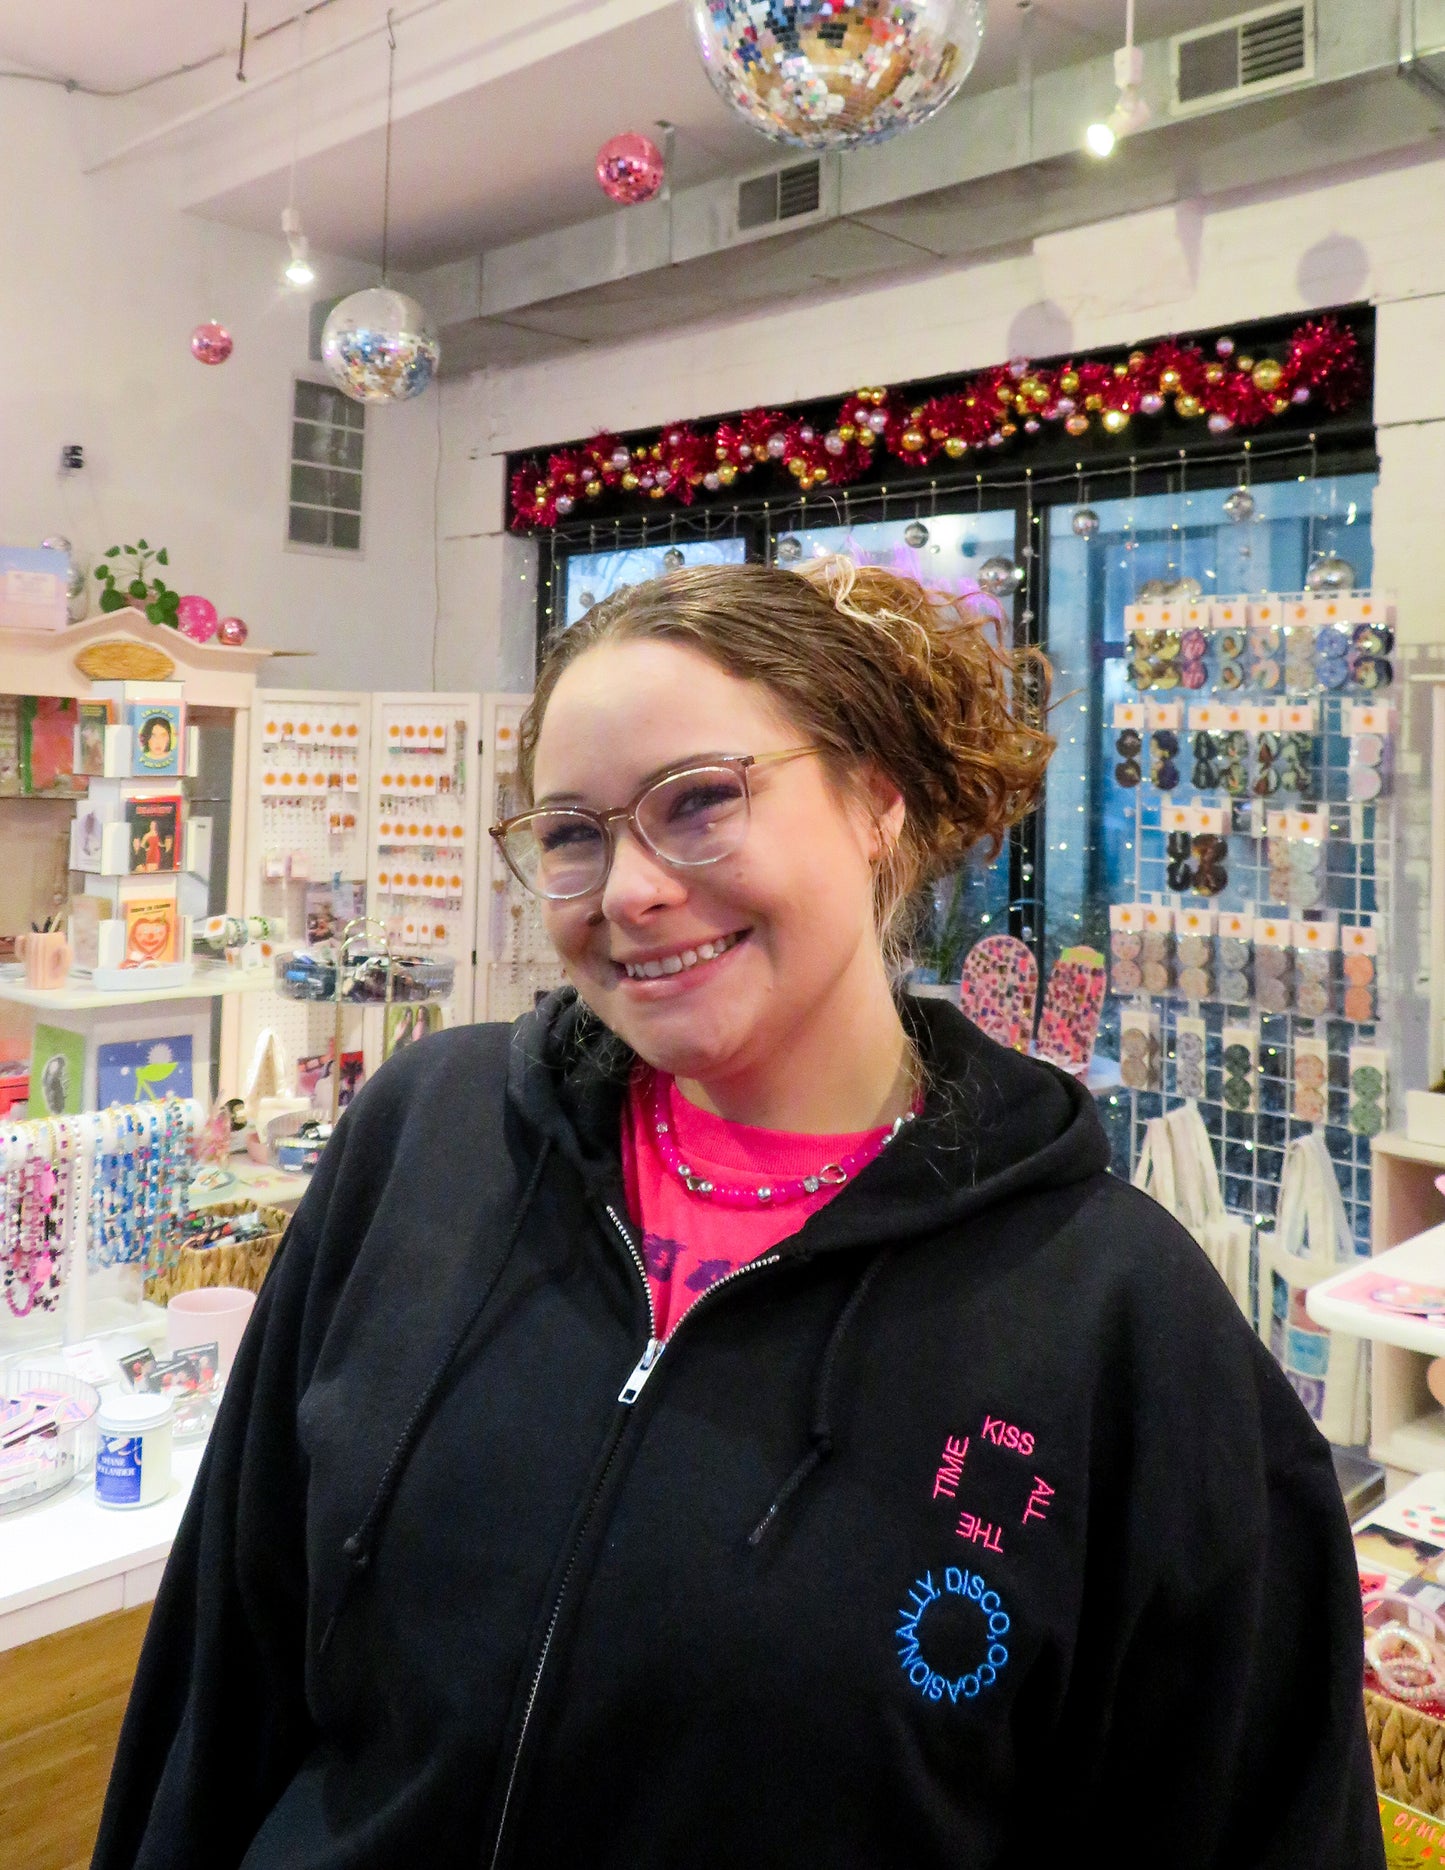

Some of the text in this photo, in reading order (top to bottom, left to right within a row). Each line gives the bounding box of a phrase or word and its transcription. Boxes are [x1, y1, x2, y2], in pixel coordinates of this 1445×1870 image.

[932, 1414, 1056, 1554] KISS ALL THE TIME
[945, 1567, 1010, 1641] DISCO,
